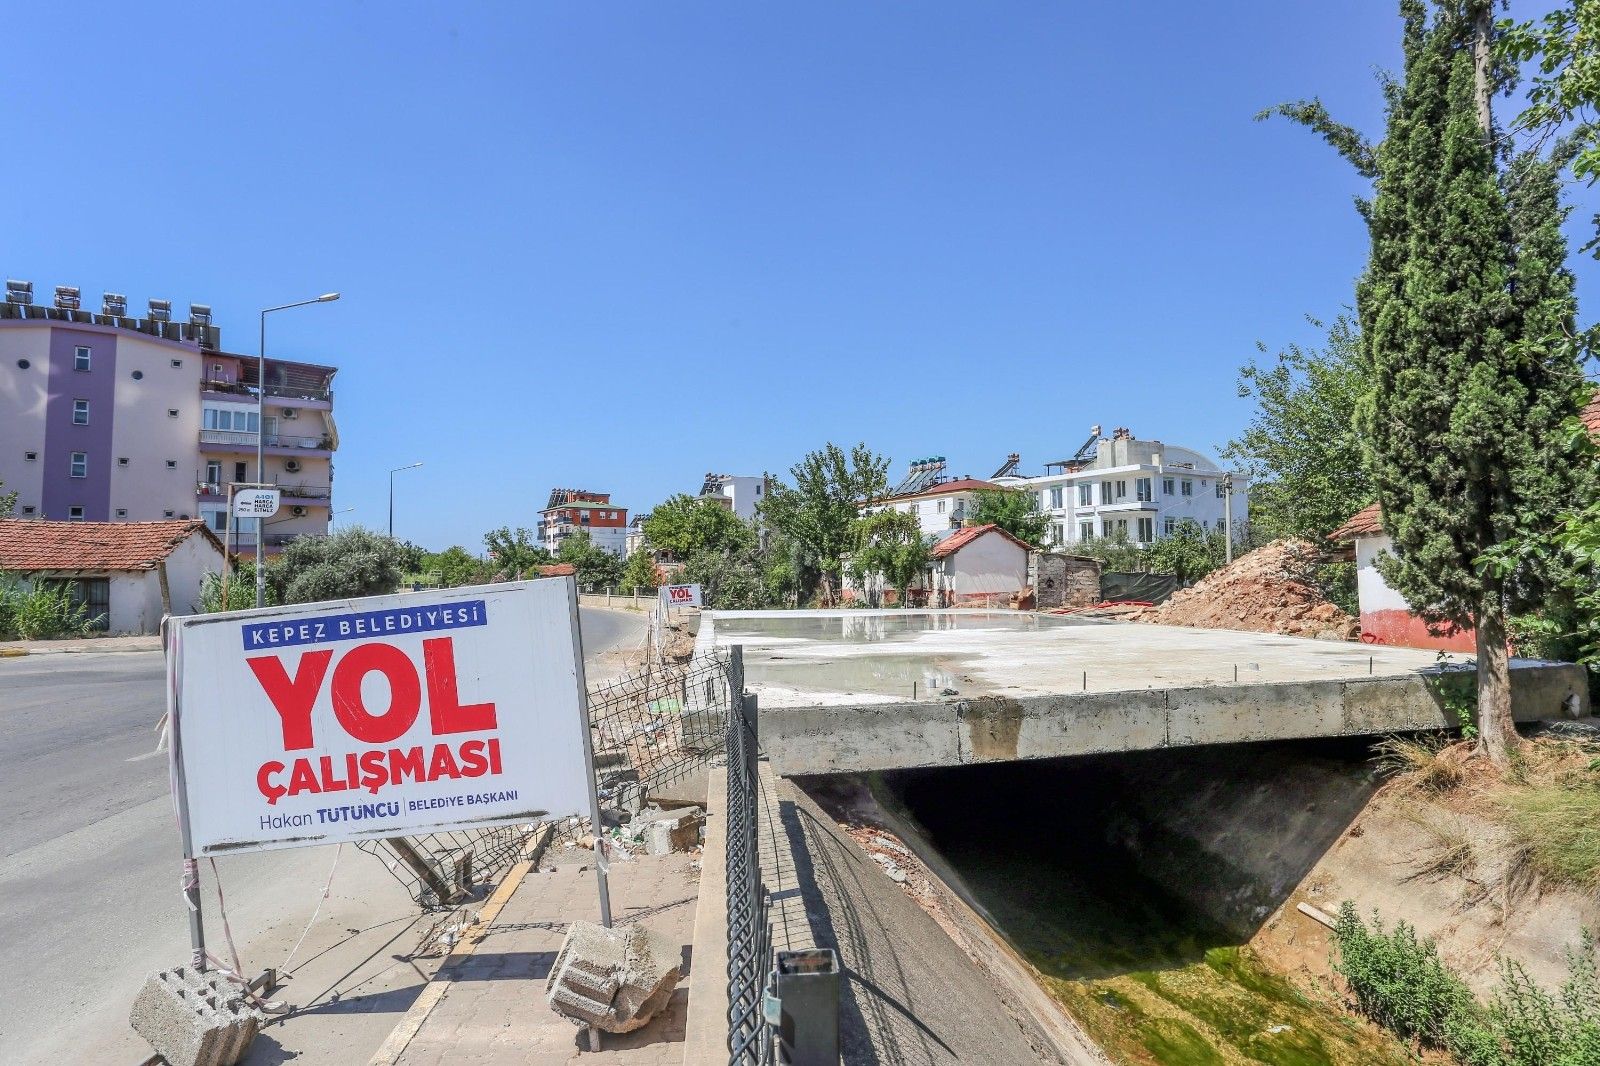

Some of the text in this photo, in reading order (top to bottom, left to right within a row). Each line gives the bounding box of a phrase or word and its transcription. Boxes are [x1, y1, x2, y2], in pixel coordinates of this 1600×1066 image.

[670, 588, 692, 598] YOL
[252, 624, 325, 645] KEPEZ
[246, 637, 497, 751] YOL
[256, 738, 502, 805] ÇALIŞMASI
[260, 814, 313, 831] Hakan
[316, 802, 400, 823] TÜTÜNCÜ
[467, 789, 519, 807] BAŞKANI
